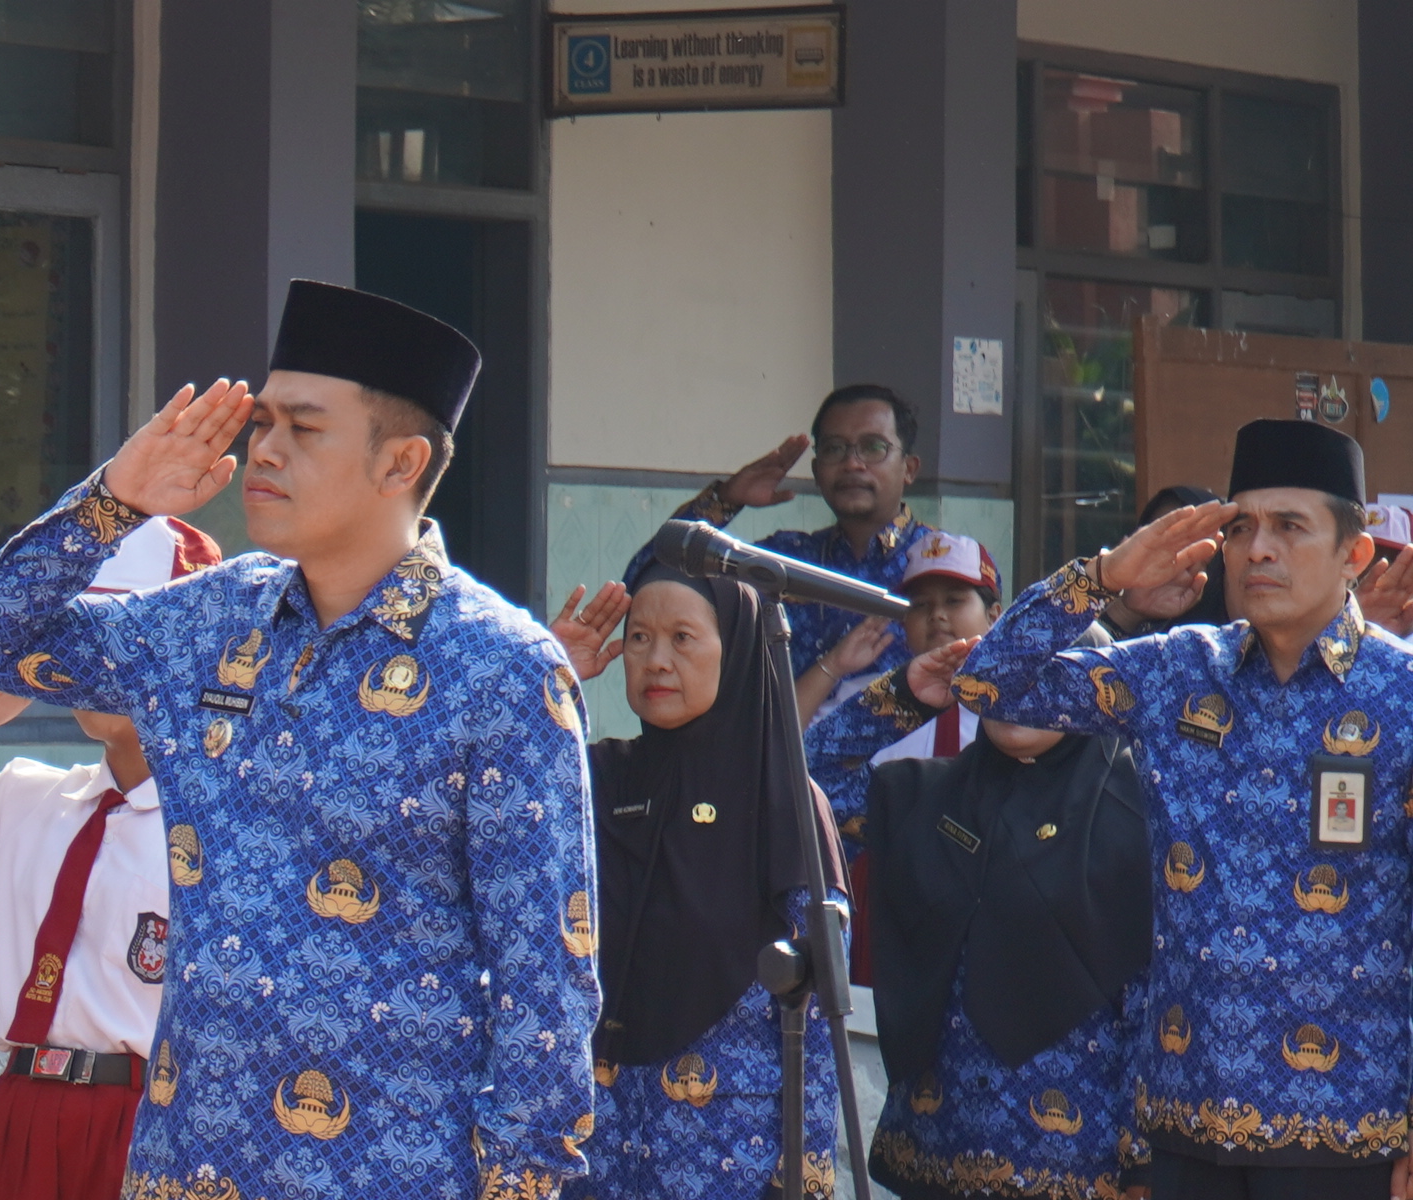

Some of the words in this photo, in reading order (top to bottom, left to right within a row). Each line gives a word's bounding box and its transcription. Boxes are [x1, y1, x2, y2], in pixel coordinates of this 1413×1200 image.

[614, 35, 668, 61] Learning
[672, 32, 721, 56] without
[633, 63, 644, 87] is
[648, 67, 655, 87] a
[658, 63, 699, 86] waste
[702, 61, 715, 84] of
[719, 64, 764, 87] energy
